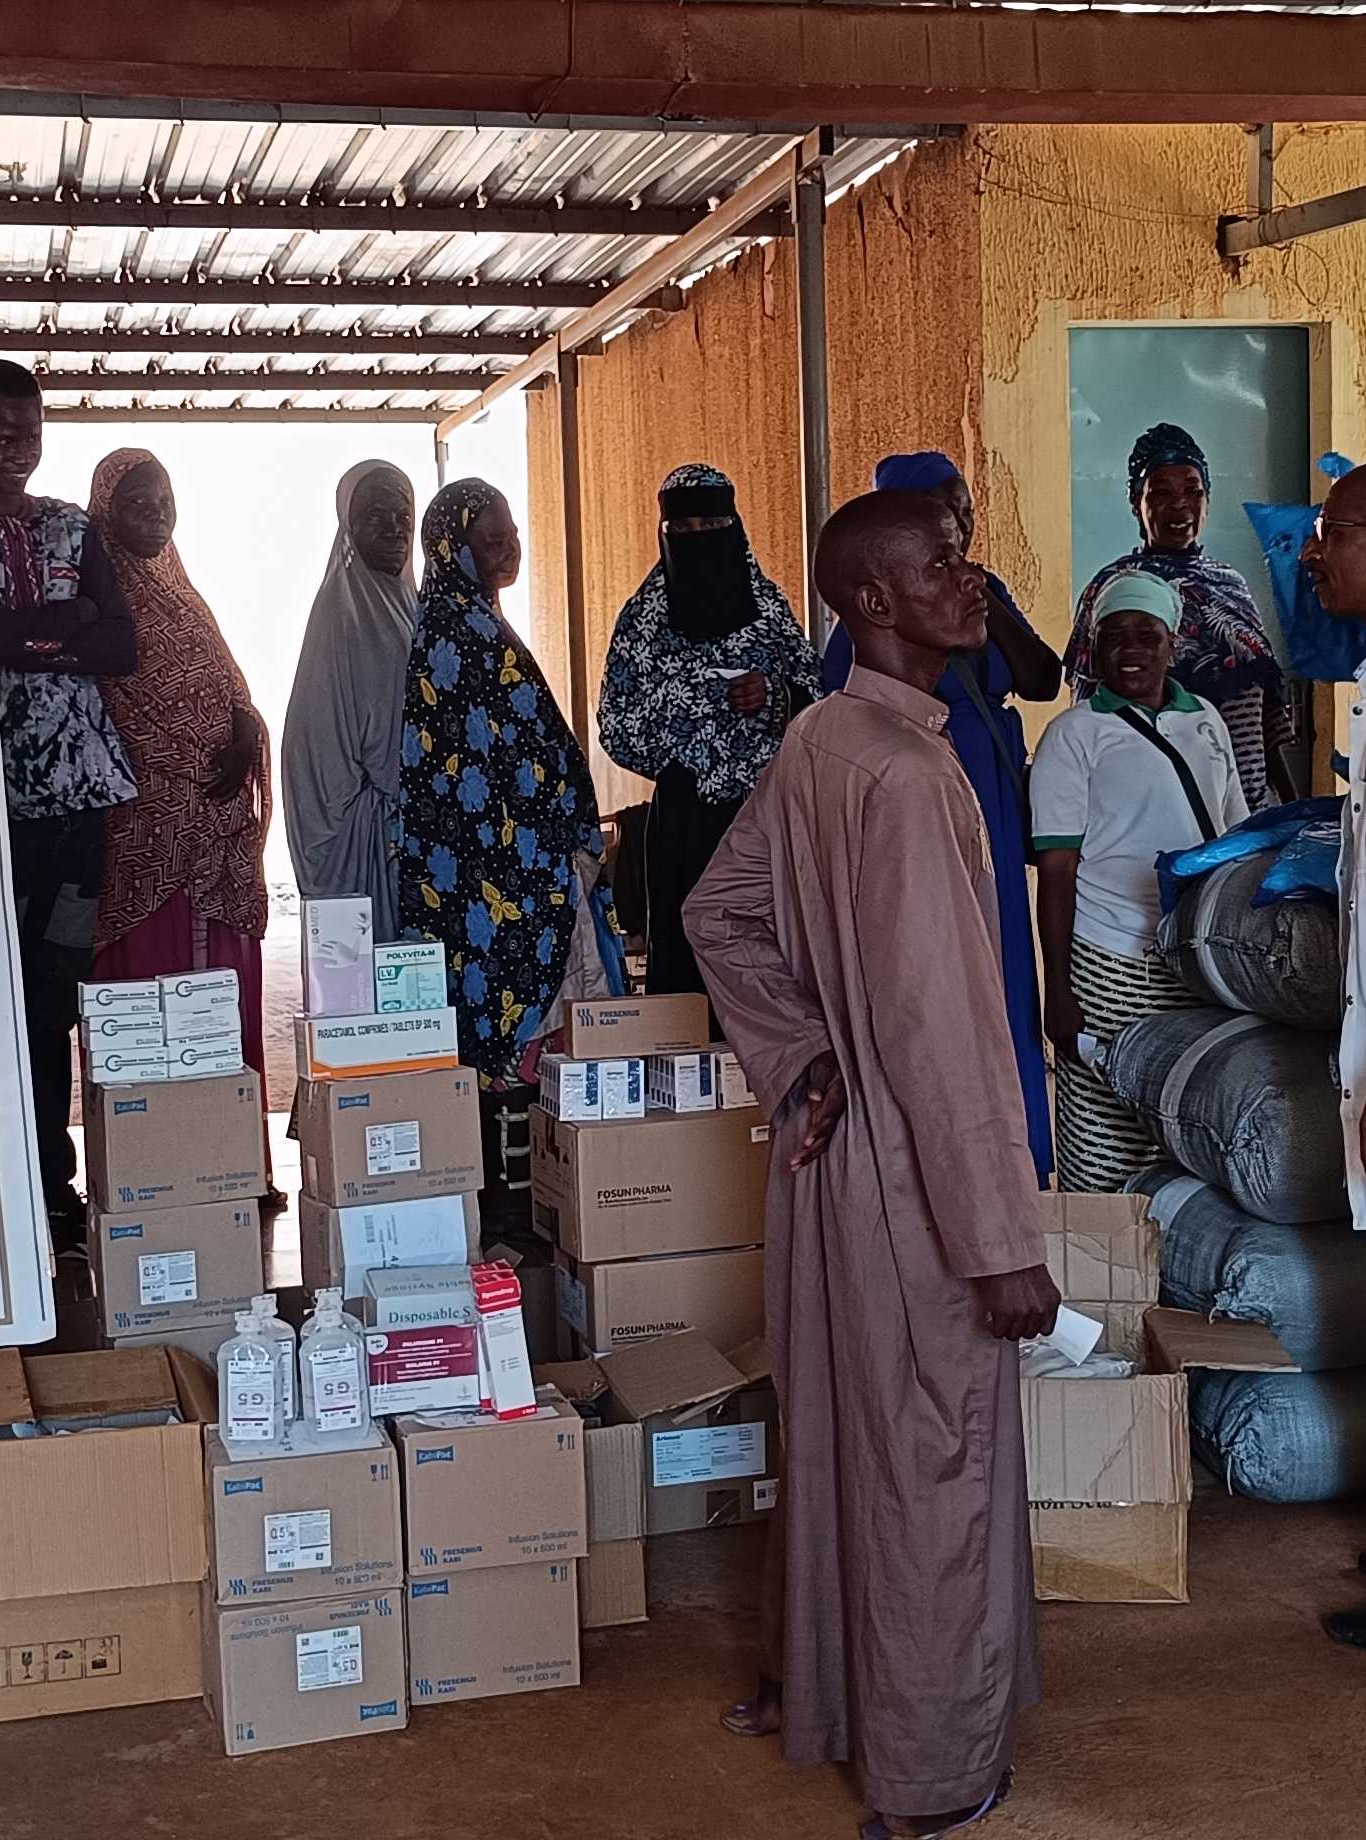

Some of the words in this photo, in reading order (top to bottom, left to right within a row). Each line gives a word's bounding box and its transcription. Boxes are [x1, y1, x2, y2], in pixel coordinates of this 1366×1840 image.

[597, 1187, 632, 1199] FOSUN
[632, 1184, 672, 1196] PHARMA
[388, 1307, 460, 1325] Disposable
[610, 1324, 646, 1337] FOSUN
[646, 1321, 686, 1333] PHARMA
